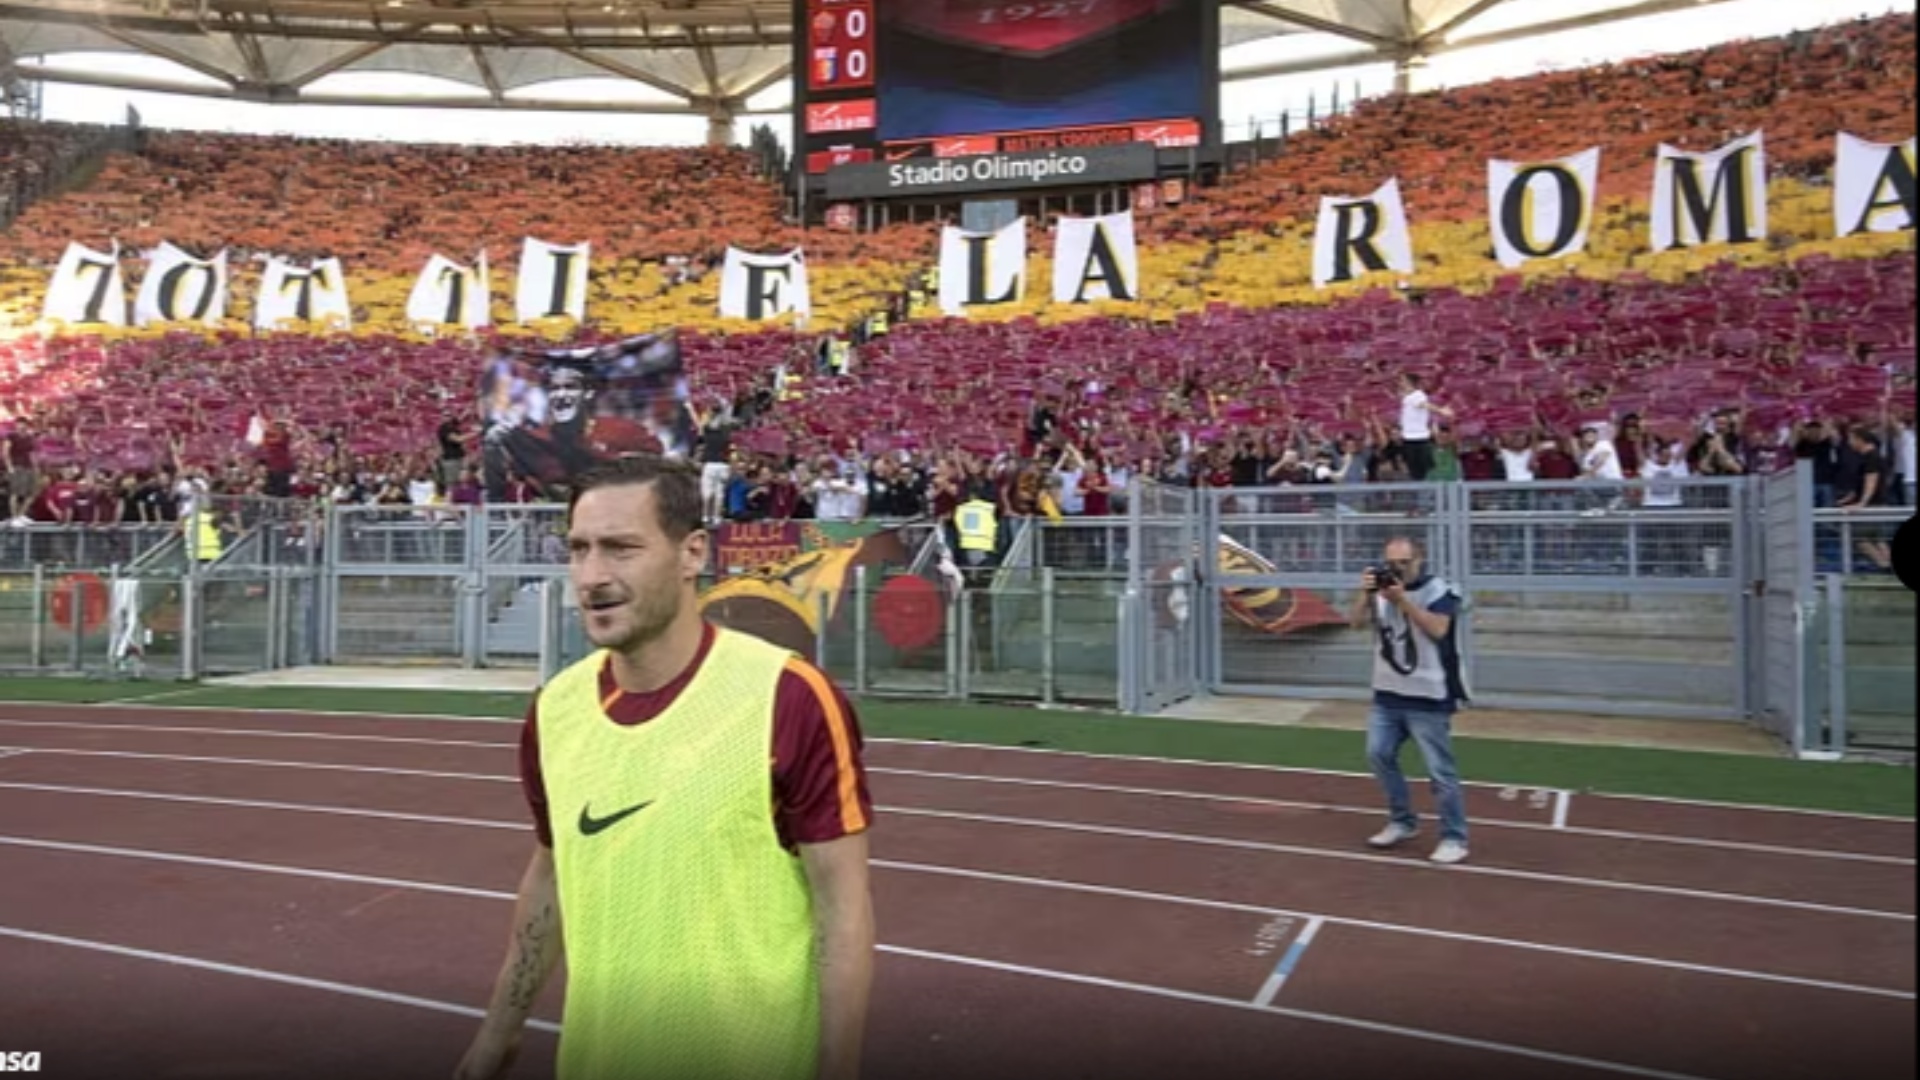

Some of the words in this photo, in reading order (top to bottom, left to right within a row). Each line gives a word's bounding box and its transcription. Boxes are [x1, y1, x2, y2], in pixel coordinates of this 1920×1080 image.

[846, 9, 866, 38] 0
[979, 0, 1097, 24] 1927
[846, 49, 866, 78] 0
[889, 160, 969, 187] Stadio
[972, 153, 1087, 181] Olimpico
[961, 223, 1134, 305] LA
[1327, 145, 1917, 283] ROMA
